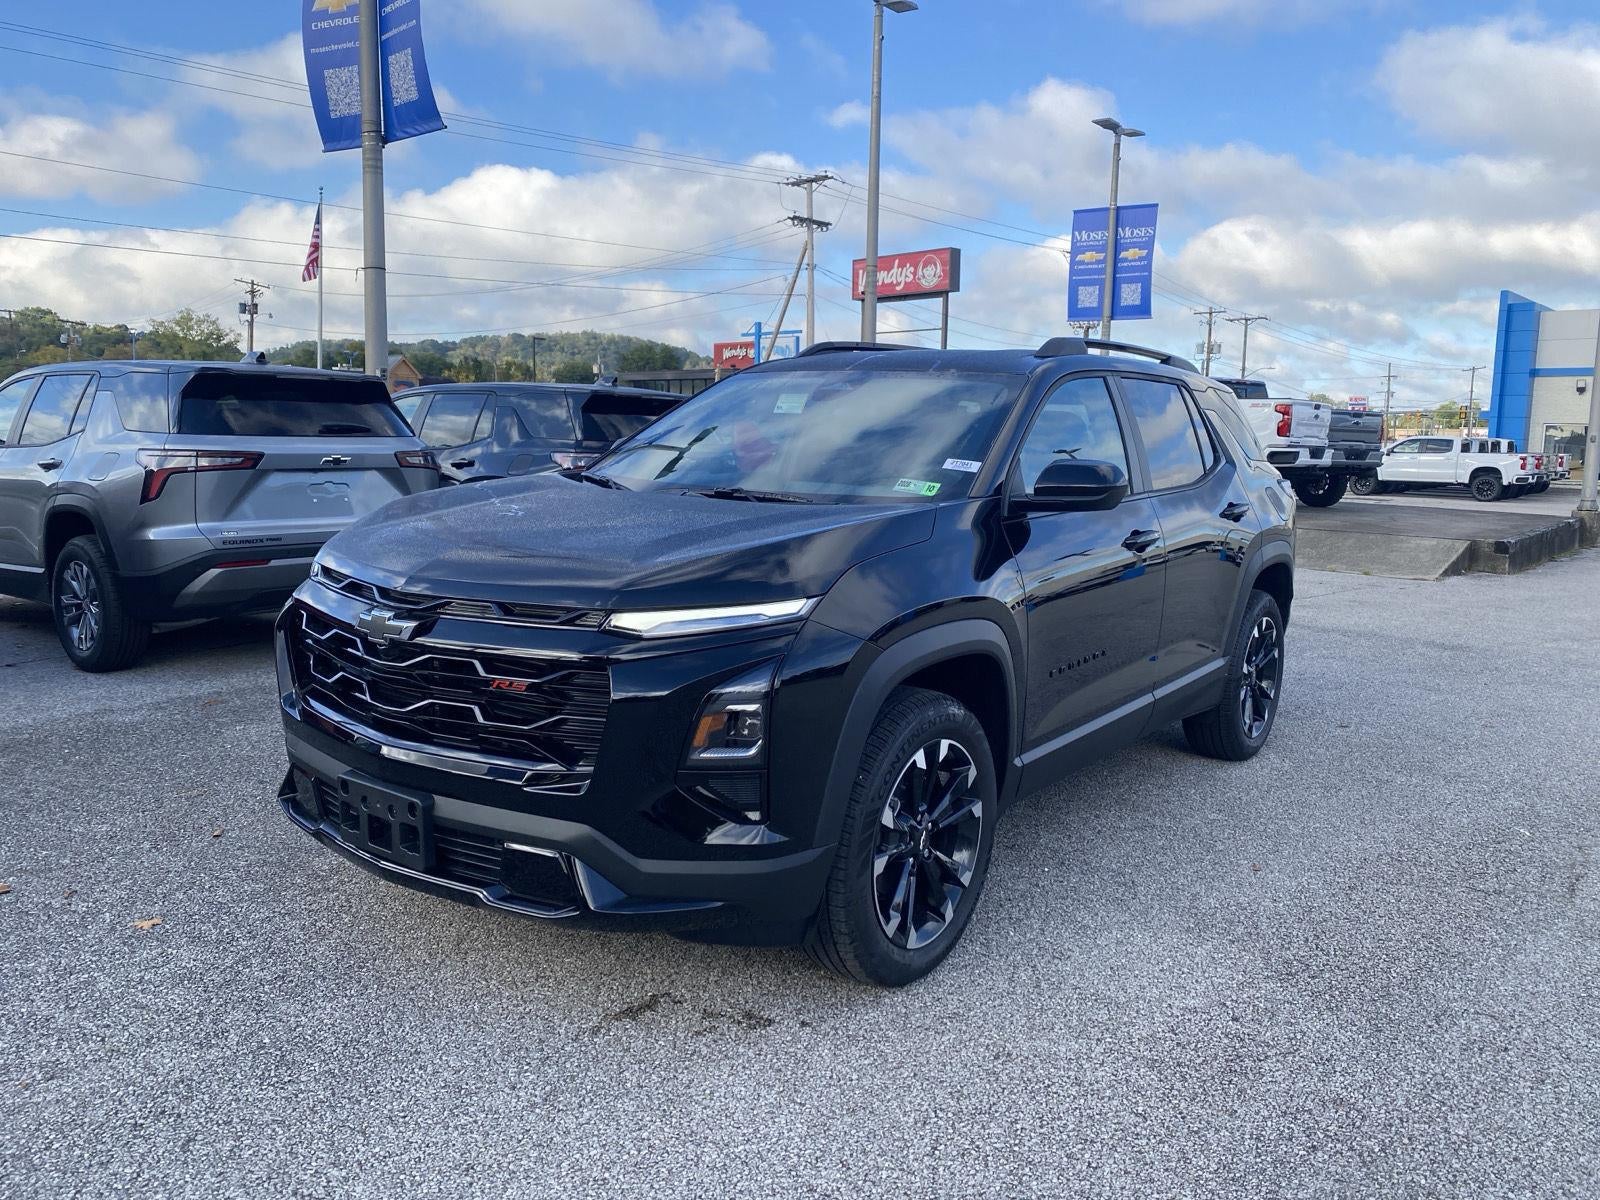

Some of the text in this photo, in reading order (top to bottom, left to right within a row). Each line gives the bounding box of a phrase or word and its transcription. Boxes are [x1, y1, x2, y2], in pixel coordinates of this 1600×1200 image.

[311, 15, 360, 30] CHEVROLE
[310, 41, 360, 54] moseschevrolet.c
[1074, 230, 1109, 242] MOSES
[1117, 226, 1154, 239] MOSES
[858, 259, 914, 292] Wndy's
[926, 484, 936, 493] 10
[491, 679, 528, 692] RS
